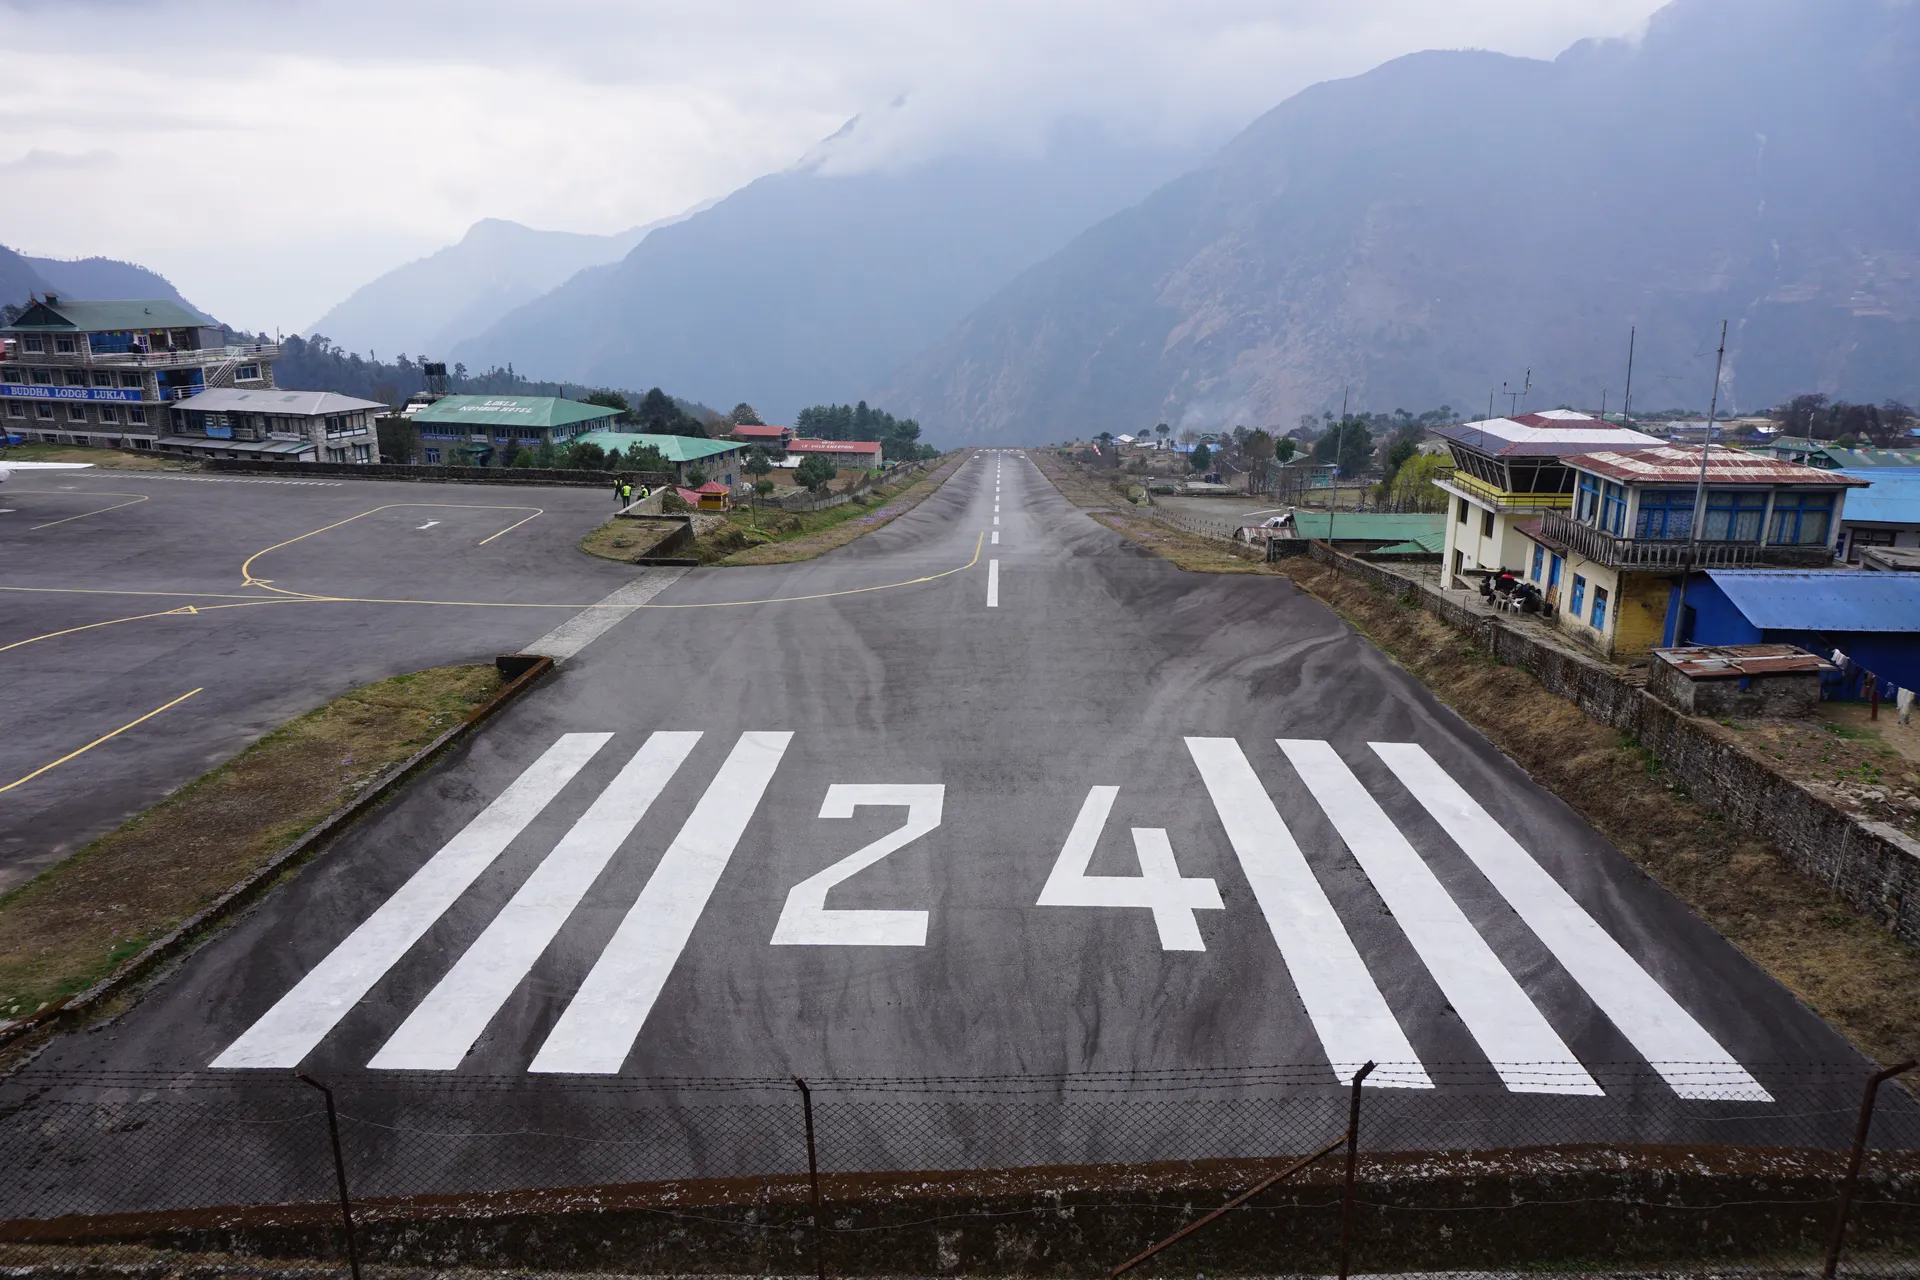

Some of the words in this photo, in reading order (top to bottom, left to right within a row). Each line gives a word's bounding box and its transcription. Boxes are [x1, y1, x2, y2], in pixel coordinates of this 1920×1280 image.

[11, 387, 50, 397] BUDDHA
[55, 388, 88, 398] LODGE
[94, 390, 126, 400] LUKLA
